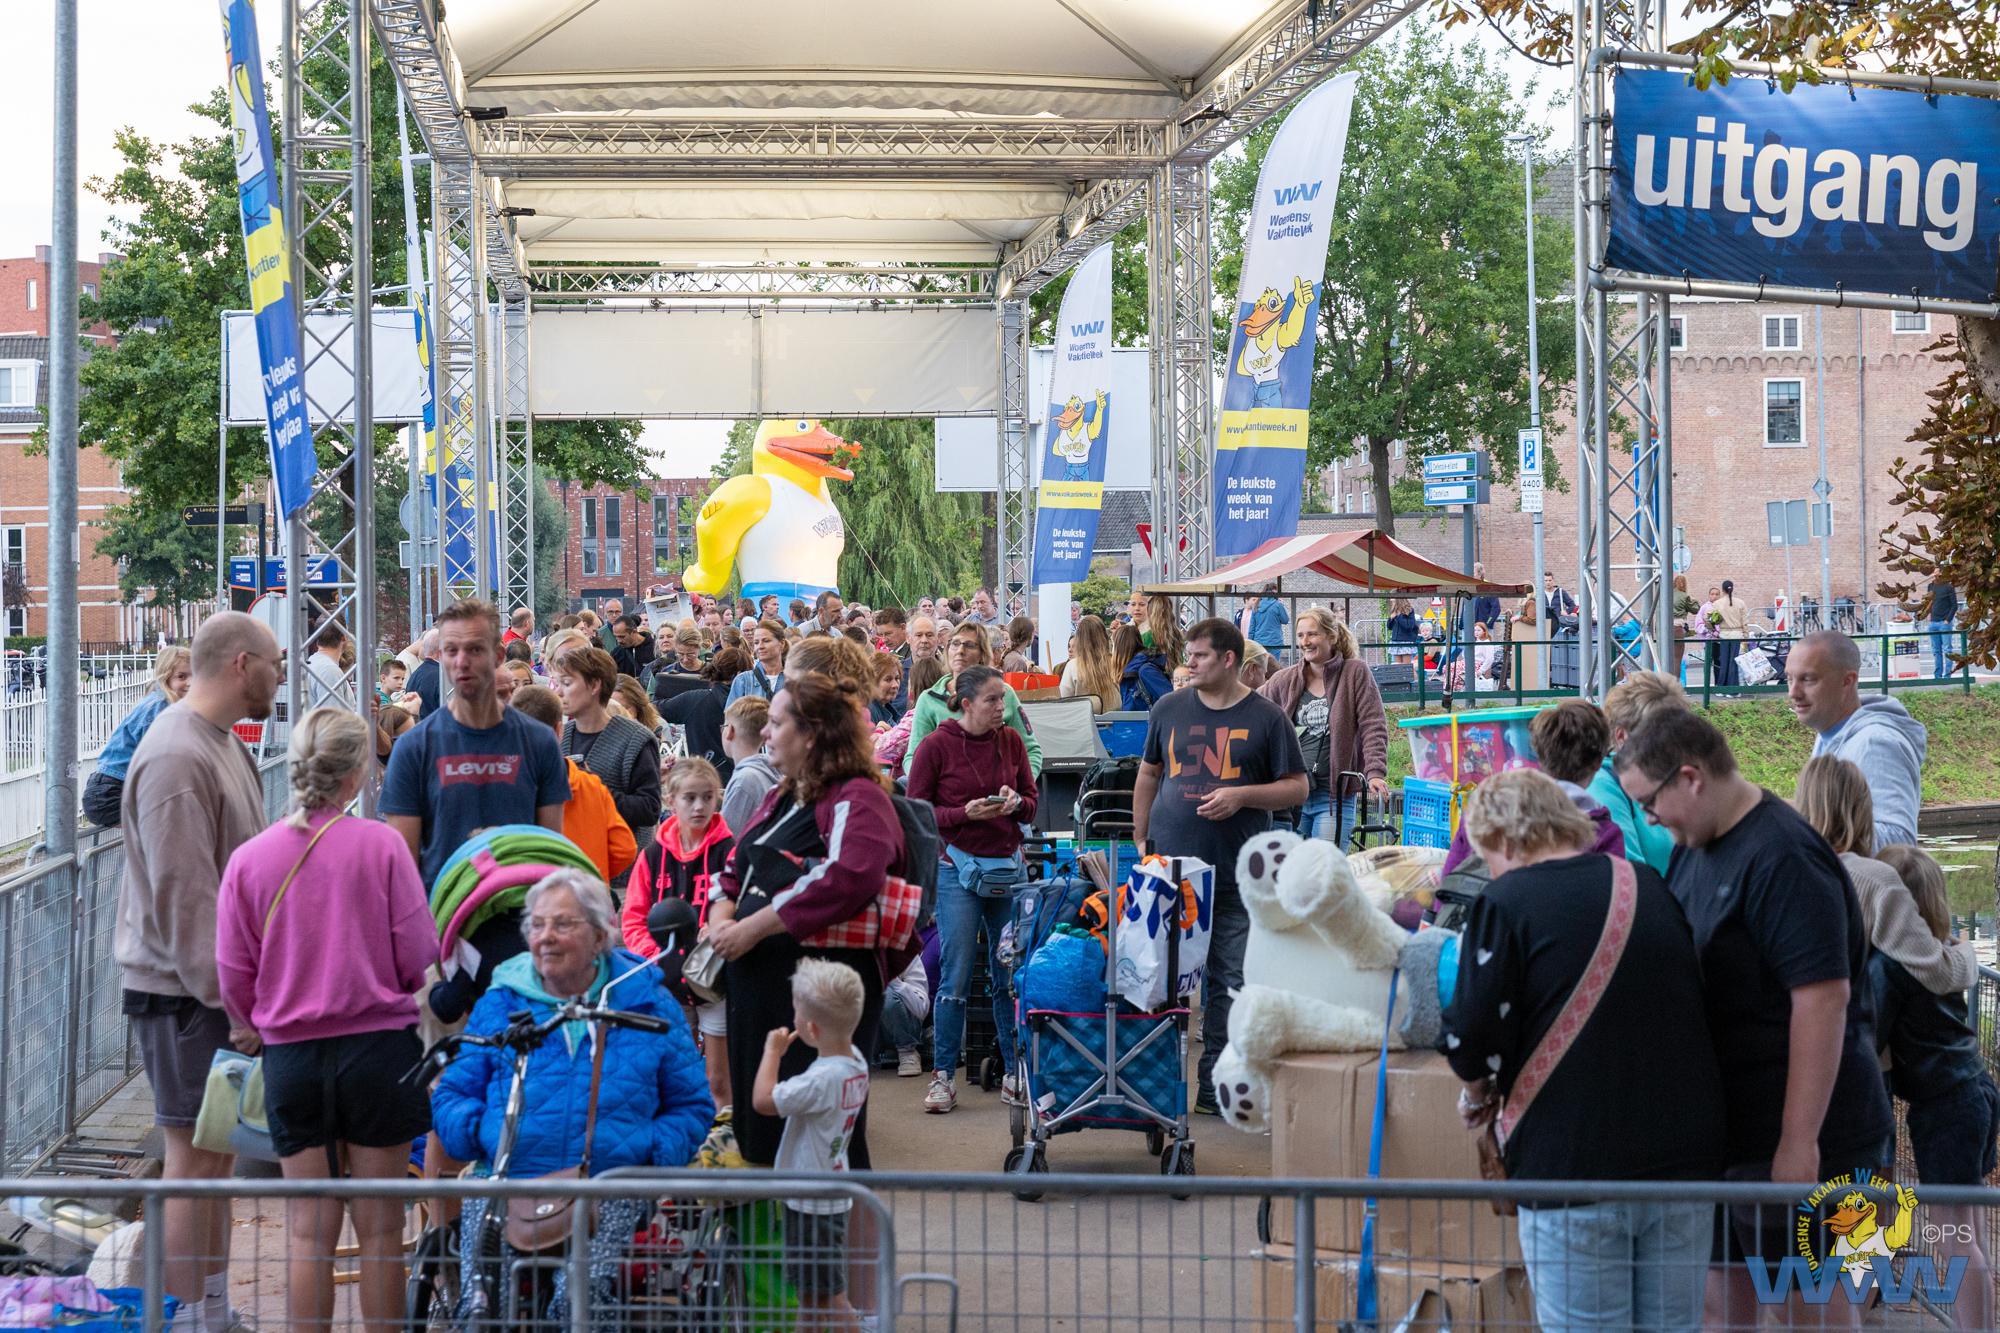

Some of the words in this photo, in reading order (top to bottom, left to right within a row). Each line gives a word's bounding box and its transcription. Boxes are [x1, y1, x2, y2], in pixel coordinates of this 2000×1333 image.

[1634, 116, 1977, 251] uitgang
[1227, 476, 1237, 489] De
[1240, 476, 1276, 489] leukste
[1522, 479, 1540, 488] 4400
[1227, 492, 1251, 505] week
[1254, 494, 1273, 504] van
[1228, 508, 1245, 520] het
[1245, 508, 1269, 521] jaar!
[1052, 528, 1061, 538] De
[1062, 528, 1086, 538] leukste
[1053, 540, 1069, 548] week
[1071, 540, 1083, 549] van
[1052, 550, 1064, 558] het
[1065, 550, 1081, 560] jaar!
